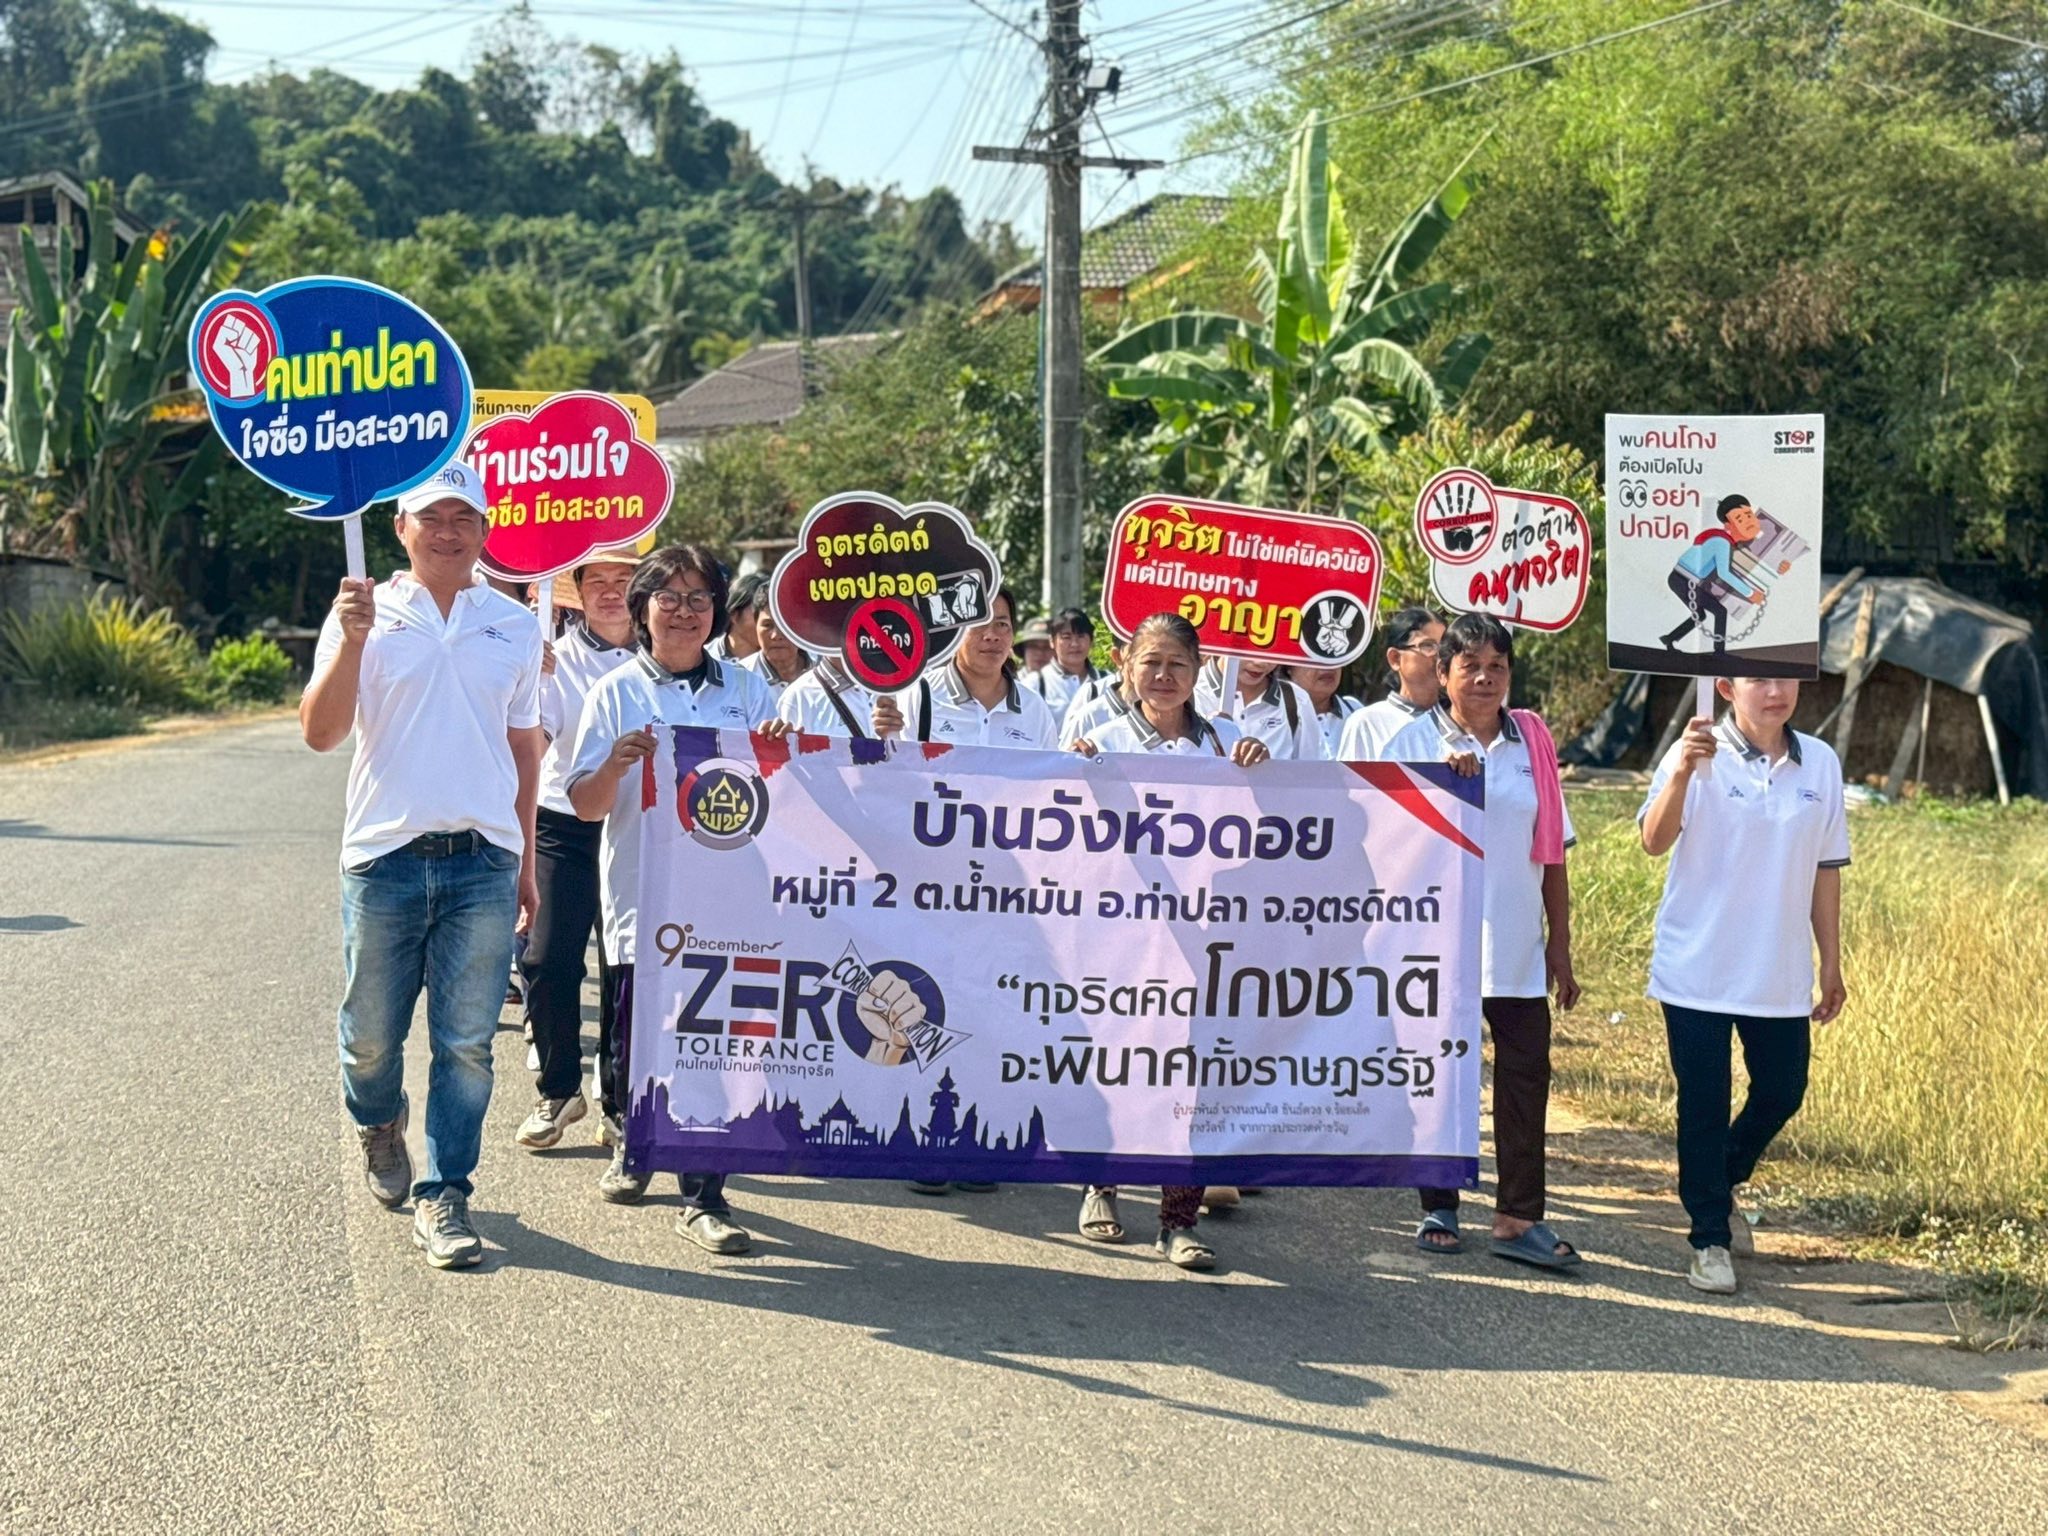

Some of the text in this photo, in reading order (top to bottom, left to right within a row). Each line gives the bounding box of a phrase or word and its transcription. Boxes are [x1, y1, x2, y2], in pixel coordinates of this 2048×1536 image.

[265, 327, 437, 401] คนท่าปลา
[240, 404, 448, 460] ใจซื่อ มือสะอาด
[1619, 425, 1717, 449] พบคนโกง
[1774, 430, 1814, 446] STOP
[467, 426, 630, 488] บ้านร่วมใจ
[1619, 457, 1703, 475] ต้องเปิดโปง
[486, 489, 644, 529] จซื่อ มือสะอาด
[1652, 483, 1700, 507] อย่า
[816, 518, 929, 568] อุตรดิตถ์
[1124, 504, 1371, 574] ทุจริต ไม่ใช่แค่ผิดวินัย
[1502, 506, 1579, 552] ต่อต้าน
[1620, 514, 1689, 540] ปกปิด
[809, 571, 938, 602] เขตปลอด
[1123, 561, 1259, 598] แต่มีโทษทาง
[1468, 539, 1579, 622] คนทุจริต
[1178, 593, 1302, 647] อาญา
[913, 781, 1335, 861] บ้านวังหัวดอย
[772, 857, 1441, 936] หมู่ที่ 2 ต.น้ำหมัน อ.ท่าปลา จ.อุตรดิตถ์
[687, 936, 783, 954] December
[676, 953, 946, 1067] ZERO
[675, 1036, 835, 1062] TOLERANCE
[675, 1056, 835, 1079] คนไทยไม่ทนต่อการทุจริต
